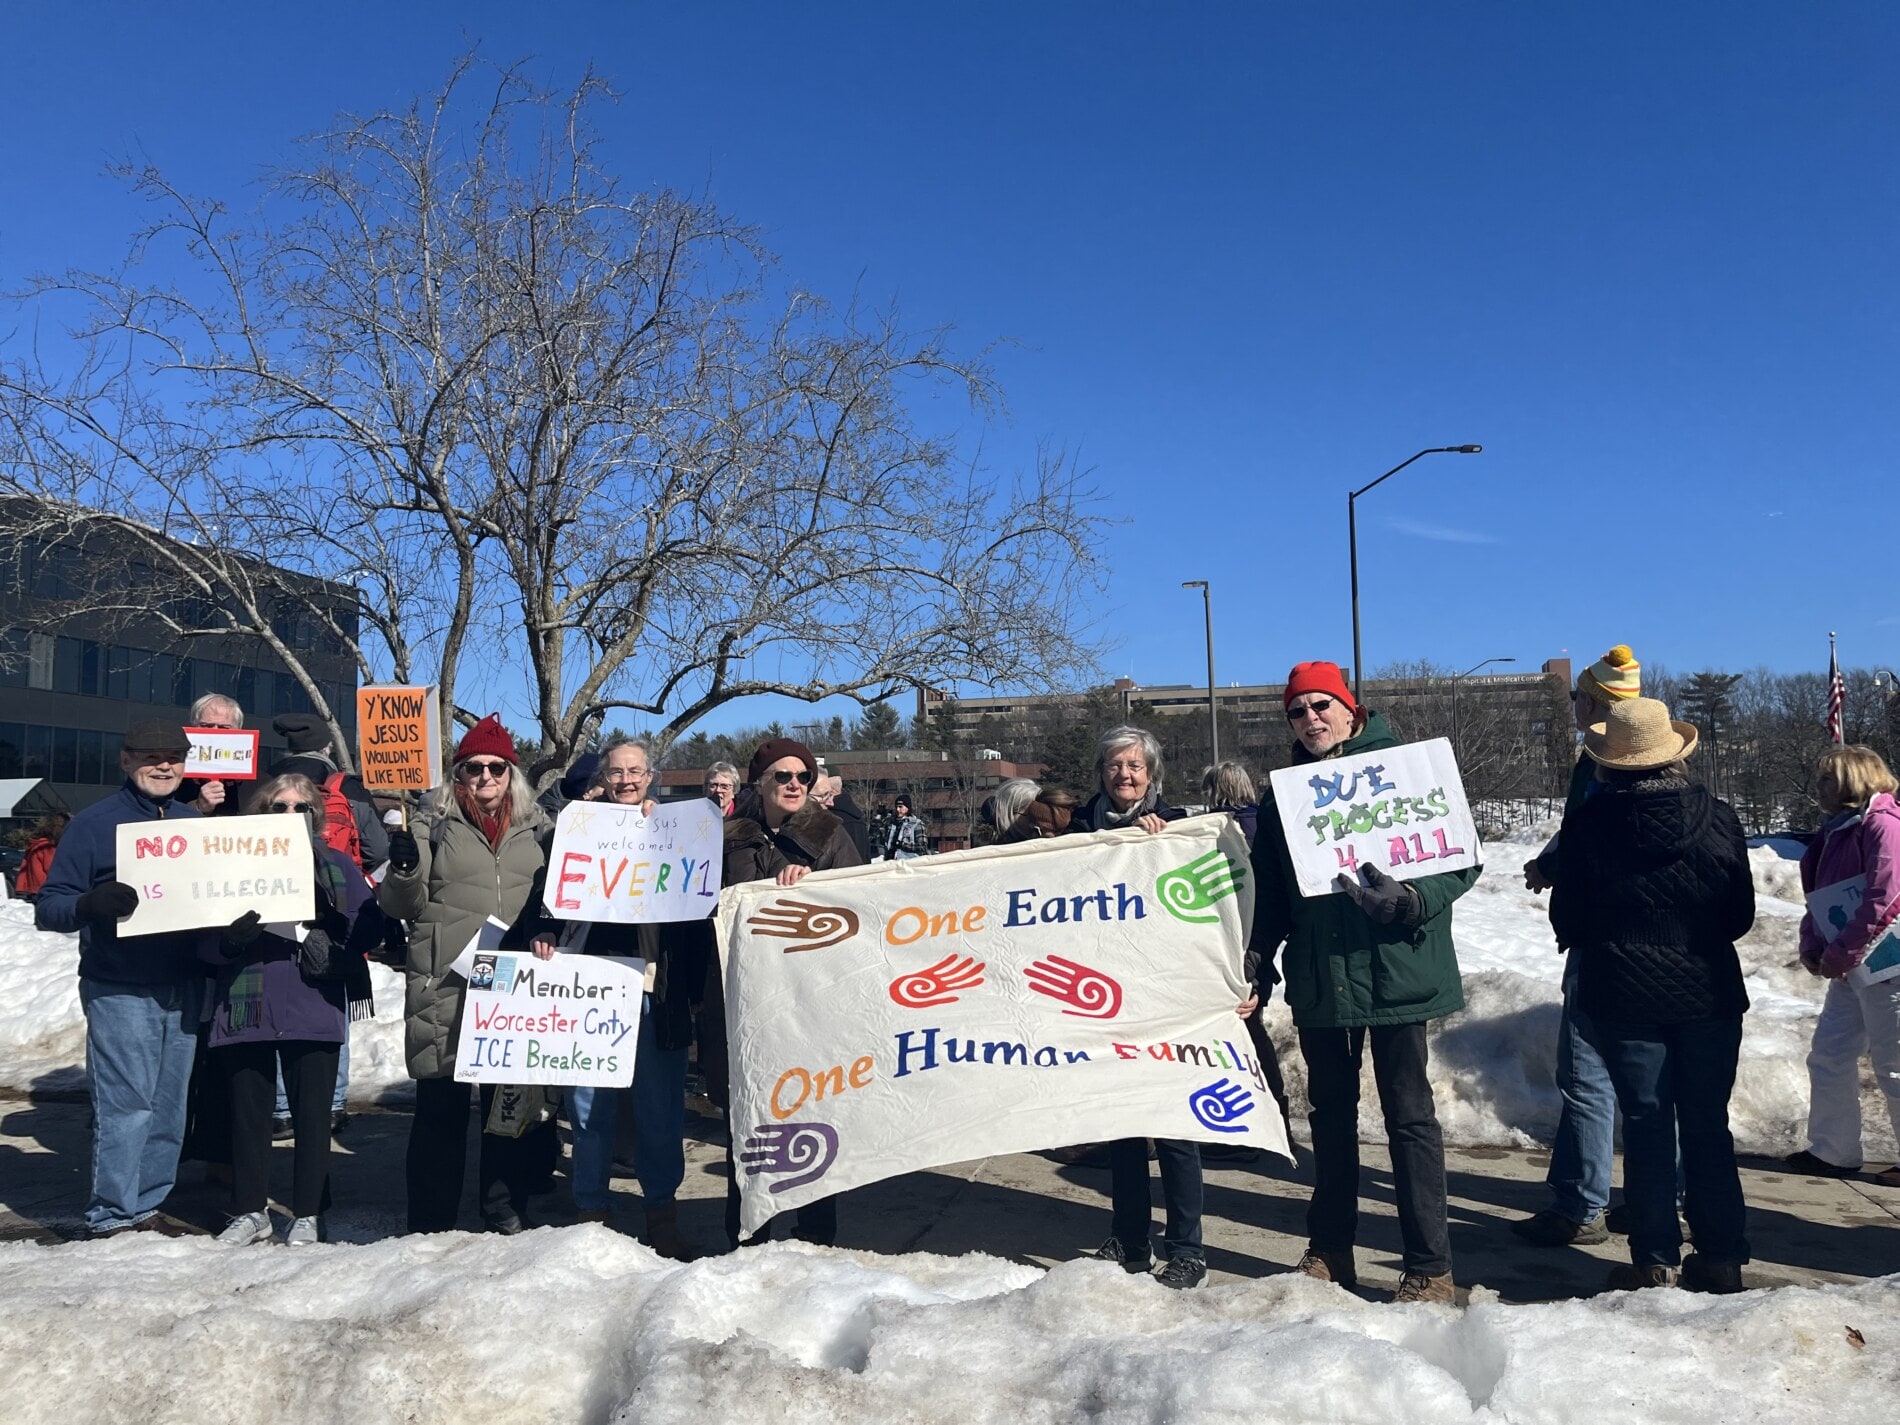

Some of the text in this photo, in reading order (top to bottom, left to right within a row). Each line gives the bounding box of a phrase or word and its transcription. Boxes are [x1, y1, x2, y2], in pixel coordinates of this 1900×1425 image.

[1458, 678, 1485, 687] Hospital
[365, 693, 424, 720] Y'KNOW
[368, 724, 419, 745] JESUS
[364, 749, 423, 765] WOULDN'T
[366, 768, 424, 784] LIKE THIS
[1308, 764, 1396, 809] DUE
[610, 807, 678, 838] Jesus
[1306, 786, 1450, 846] PROCESS
[136, 835, 290, 859] NO HUMAN
[597, 836, 673, 852] welcomed
[1334, 827, 1465, 873] 4 ALL
[143, 877, 300, 900] IS ILLEGAL
[555, 851, 714, 910] EVERY1
[885, 882, 1147, 946] One Earth
[511, 967, 627, 1000] Member:
[475, 1002, 633, 1047] Worcester Cnty
[469, 1036, 618, 1073] ICE Breakers
[770, 1027, 1267, 1120] One Human Family
